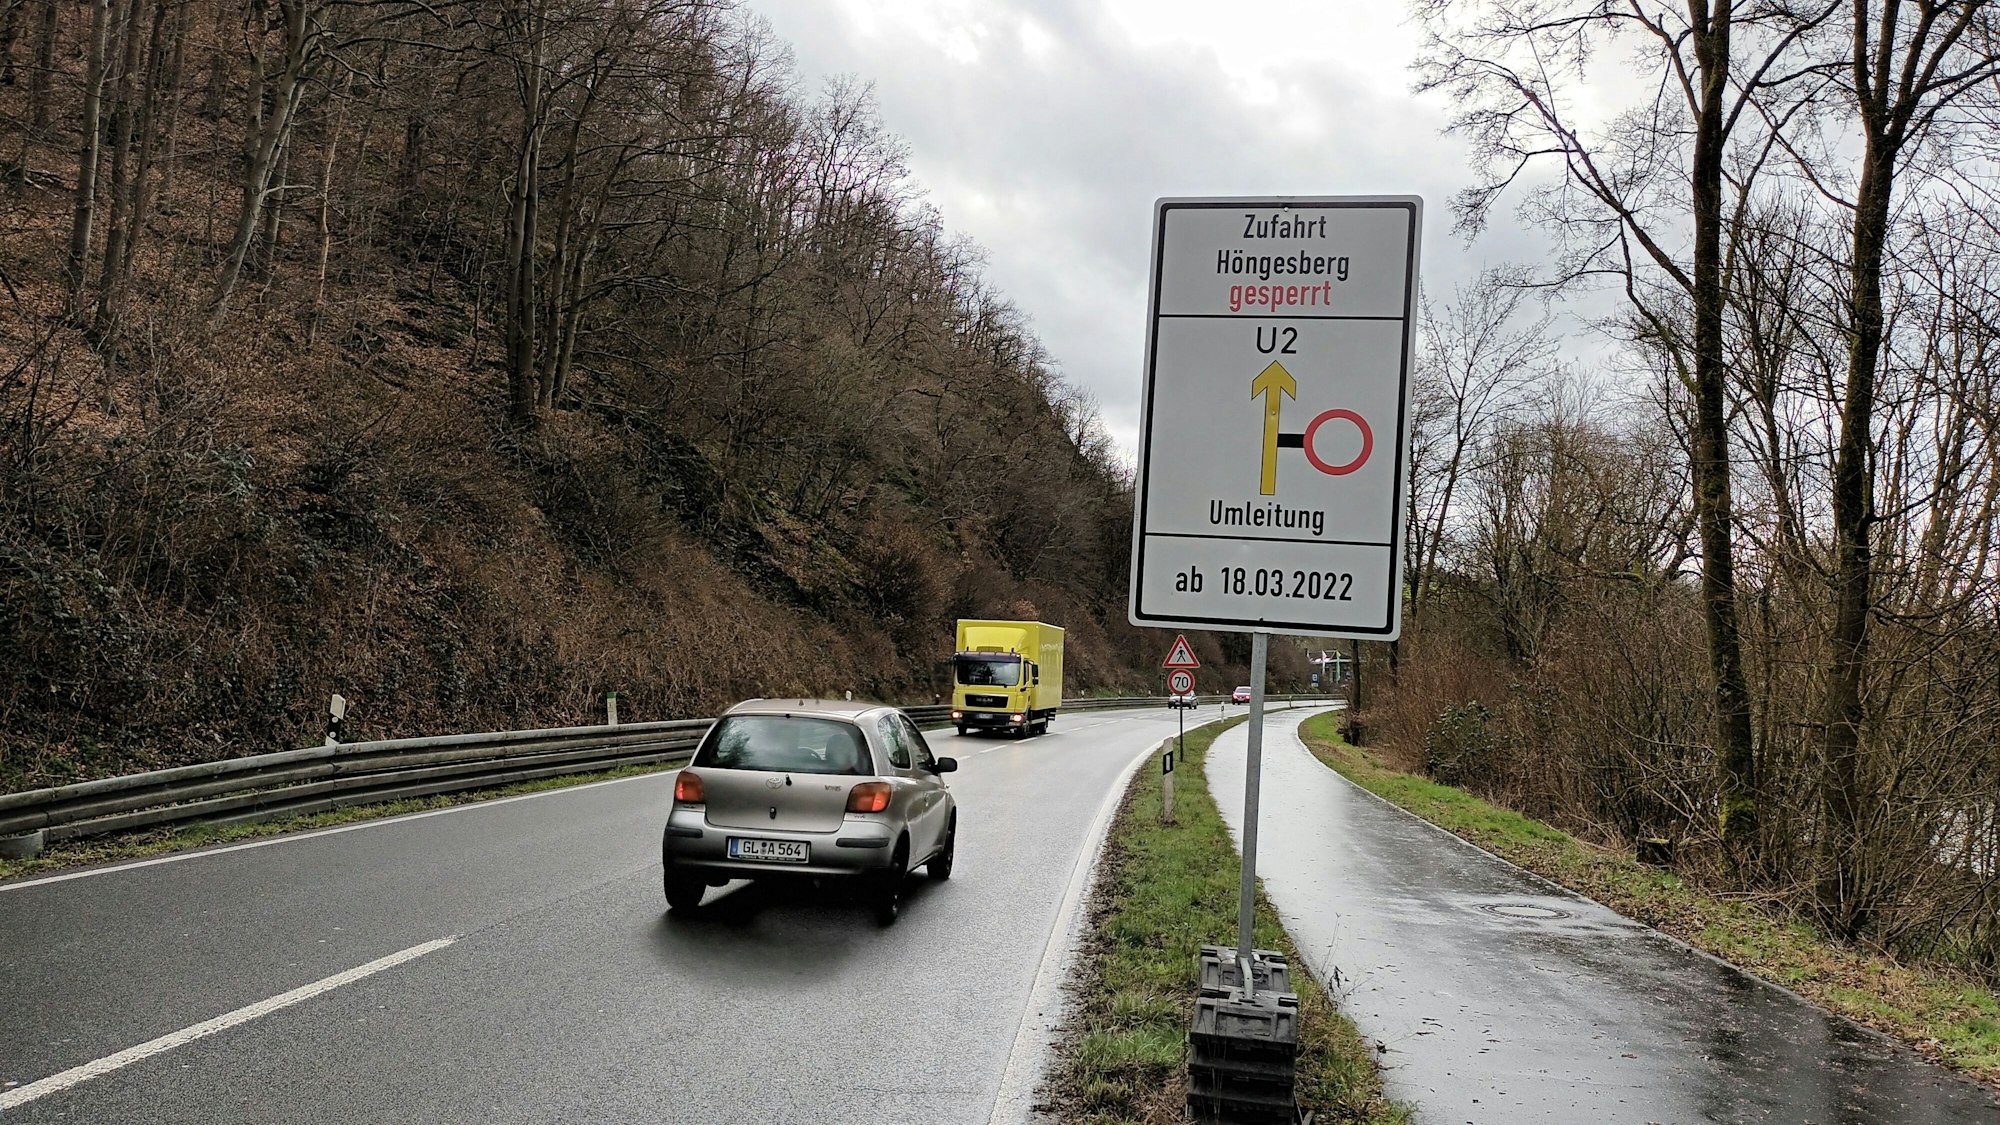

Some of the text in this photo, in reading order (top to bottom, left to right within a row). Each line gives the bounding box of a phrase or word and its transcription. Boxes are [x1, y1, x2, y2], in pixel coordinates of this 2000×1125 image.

[1243, 213, 1327, 239] Zufahrt
[1216, 249, 1350, 282] Höngesberg
[1229, 280, 1331, 313] gesperrt
[1255, 326, 1297, 355] U2
[1209, 499, 1325, 536] Umleitung
[1175, 566, 1354, 601] ab 18.03.2022
[1174, 676, 1189, 689] 70
[743, 841, 801, 857] GL A 564
